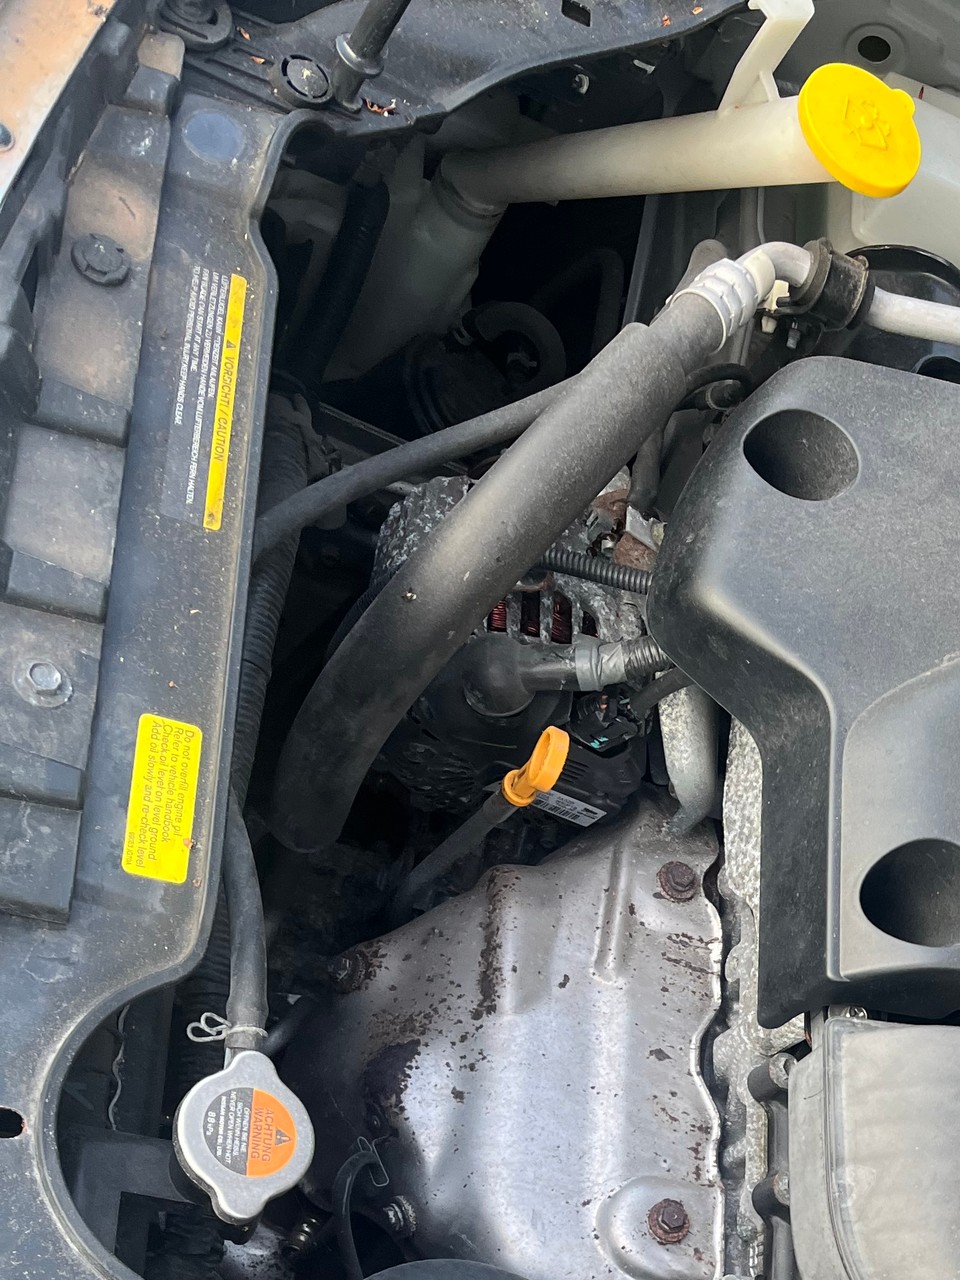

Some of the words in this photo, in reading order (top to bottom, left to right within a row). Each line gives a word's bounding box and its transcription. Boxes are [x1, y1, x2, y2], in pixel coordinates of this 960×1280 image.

[219, 354, 234, 408] VORSICHT!
[213, 416, 227, 461] CAUTION
[150, 720, 162, 740] Add
[160, 724, 173, 753] Check
[171, 726, 183, 751] Refer
[183, 729, 194, 742] Do
[149, 742, 160, 753] oil
[170, 753, 179, 762] to
[182, 745, 192, 759] not
[146, 754, 157, 783] slowly
[158, 755, 169, 766] oil
[156, 768, 167, 789] level
[167, 764, 178, 795] vehicle
[178, 762, 190, 790] overfill
[143, 784, 154, 802] and
[154, 790, 163, 802] on
[151, 804, 163, 825] level
[173, 792, 185, 823] engine
[139, 804, 151, 844] re-check
[160, 797, 176, 842] handbook
[147, 827, 160, 860] ground
[134, 846, 146, 867] level
[228, 1091, 236, 1110] NEVER
[207, 1111, 216, 1123] 88
[227, 1112, 235, 1129] OPEN
[225, 1130, 233, 1149] WHEN
[251, 1106, 263, 1158] WARNING
[262, 1107, 274, 1161] ACHTUNG
